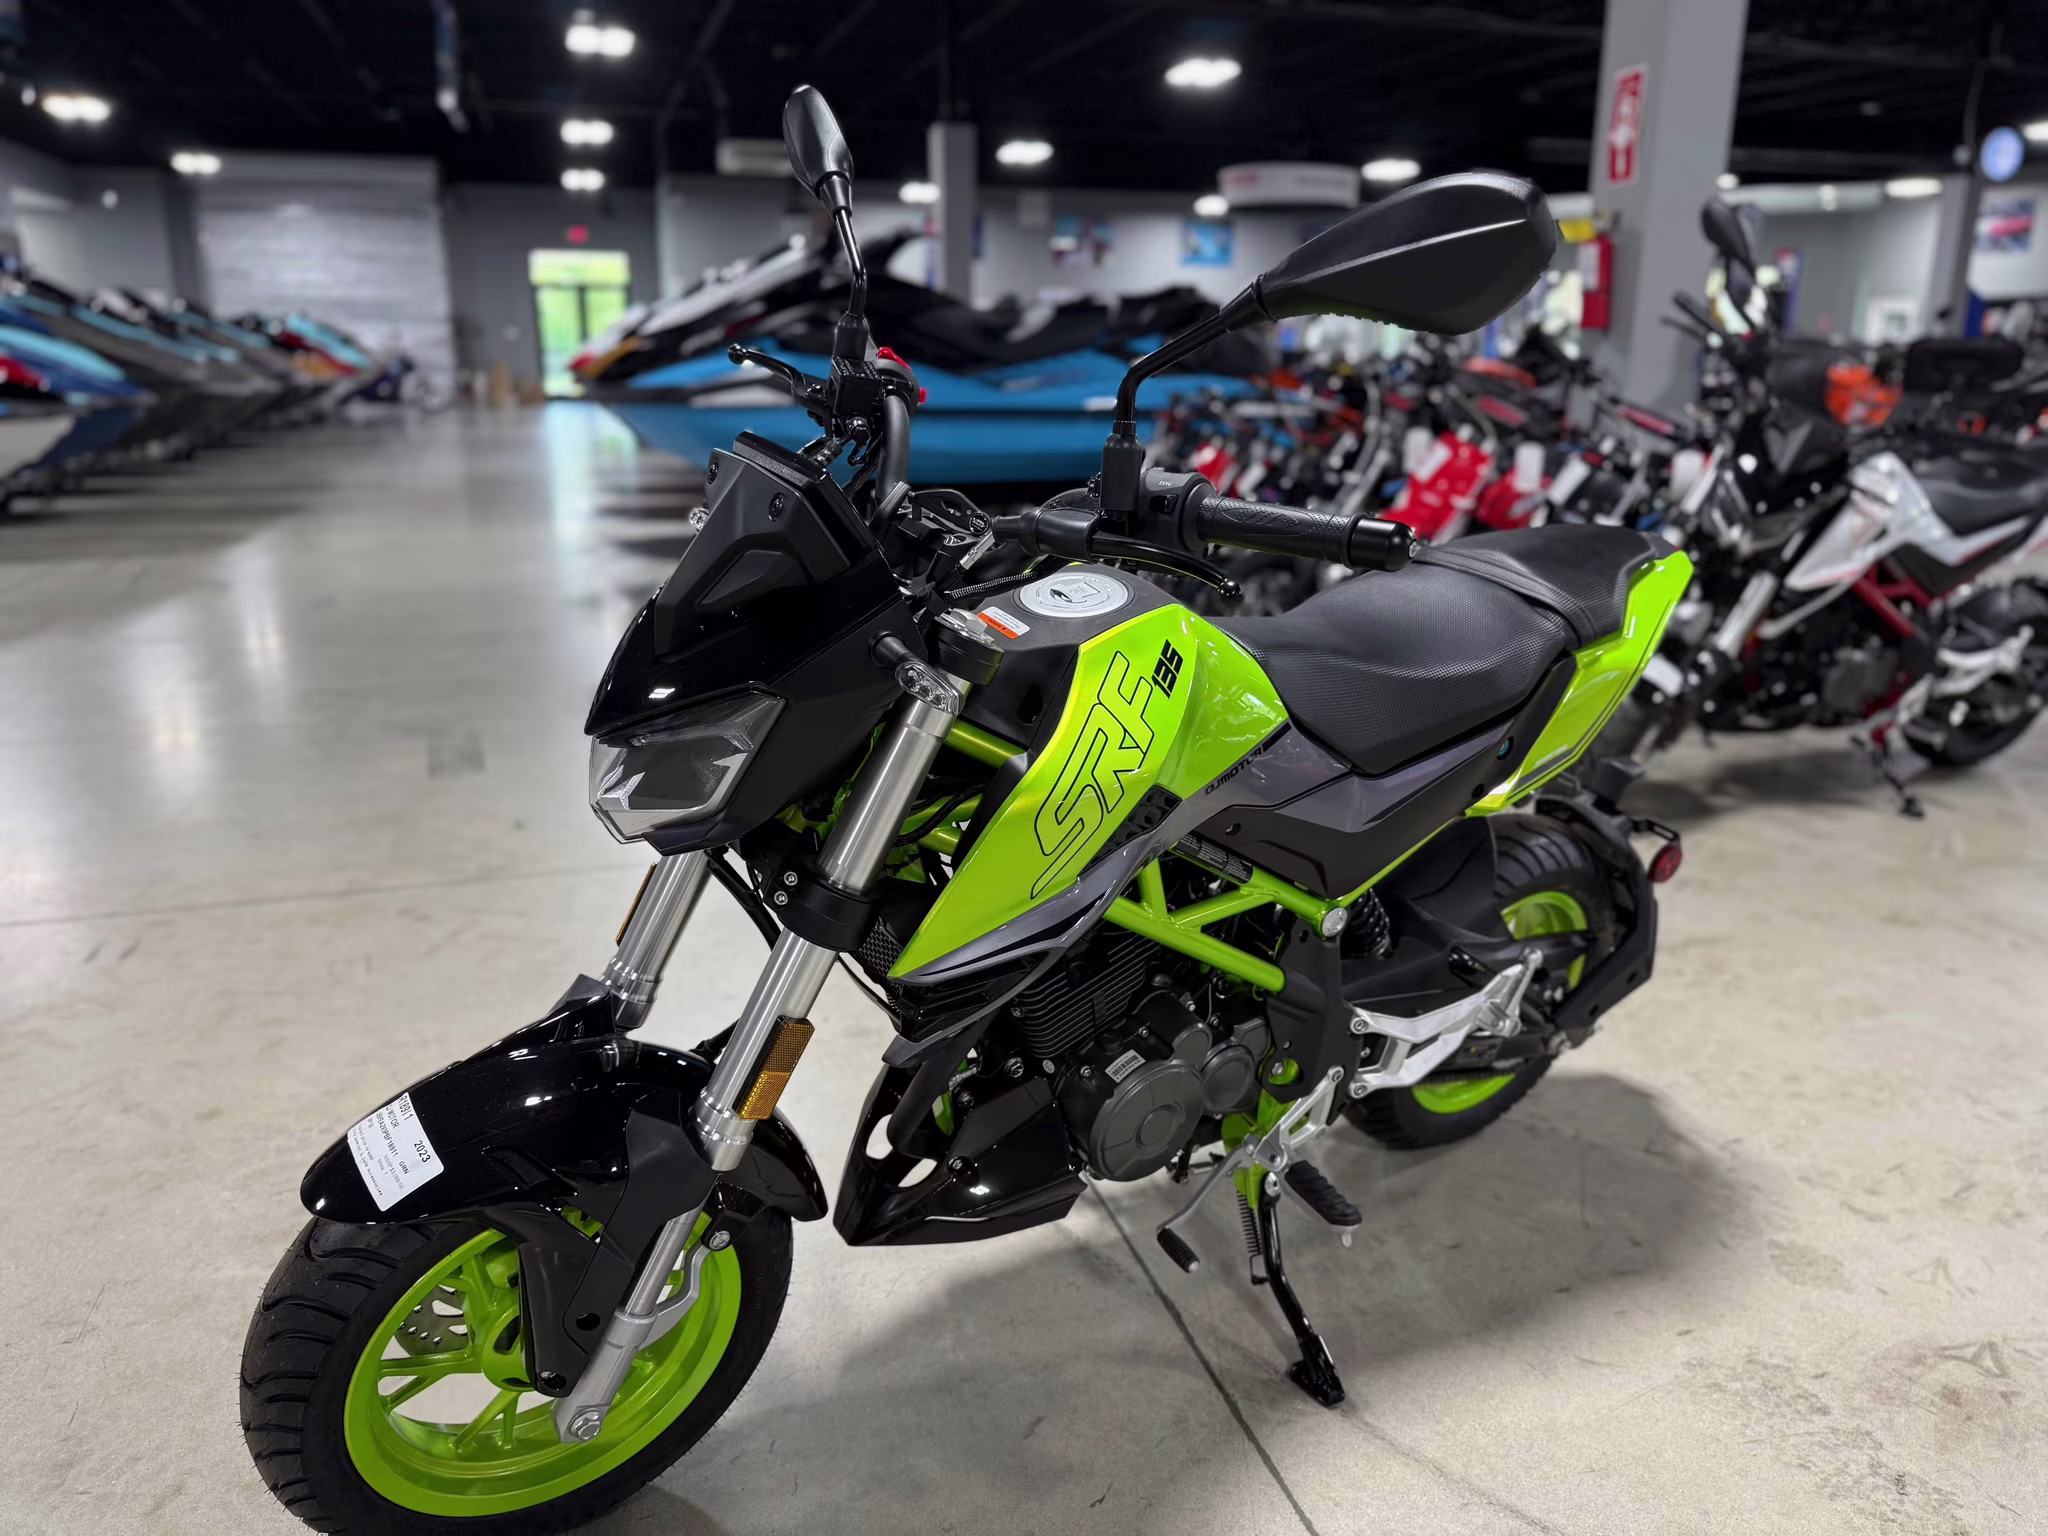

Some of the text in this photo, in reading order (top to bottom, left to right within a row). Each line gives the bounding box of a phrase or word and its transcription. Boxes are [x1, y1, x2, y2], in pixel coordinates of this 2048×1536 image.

[1151, 639, 1184, 699] 135
[1031, 650, 1155, 900] SRF
[1205, 746, 1263, 796] QJMOTOR
[388, 1109, 400, 1130] MOTOR
[398, 1160, 410, 1175] GRN
[413, 1140, 432, 1163] 2023
